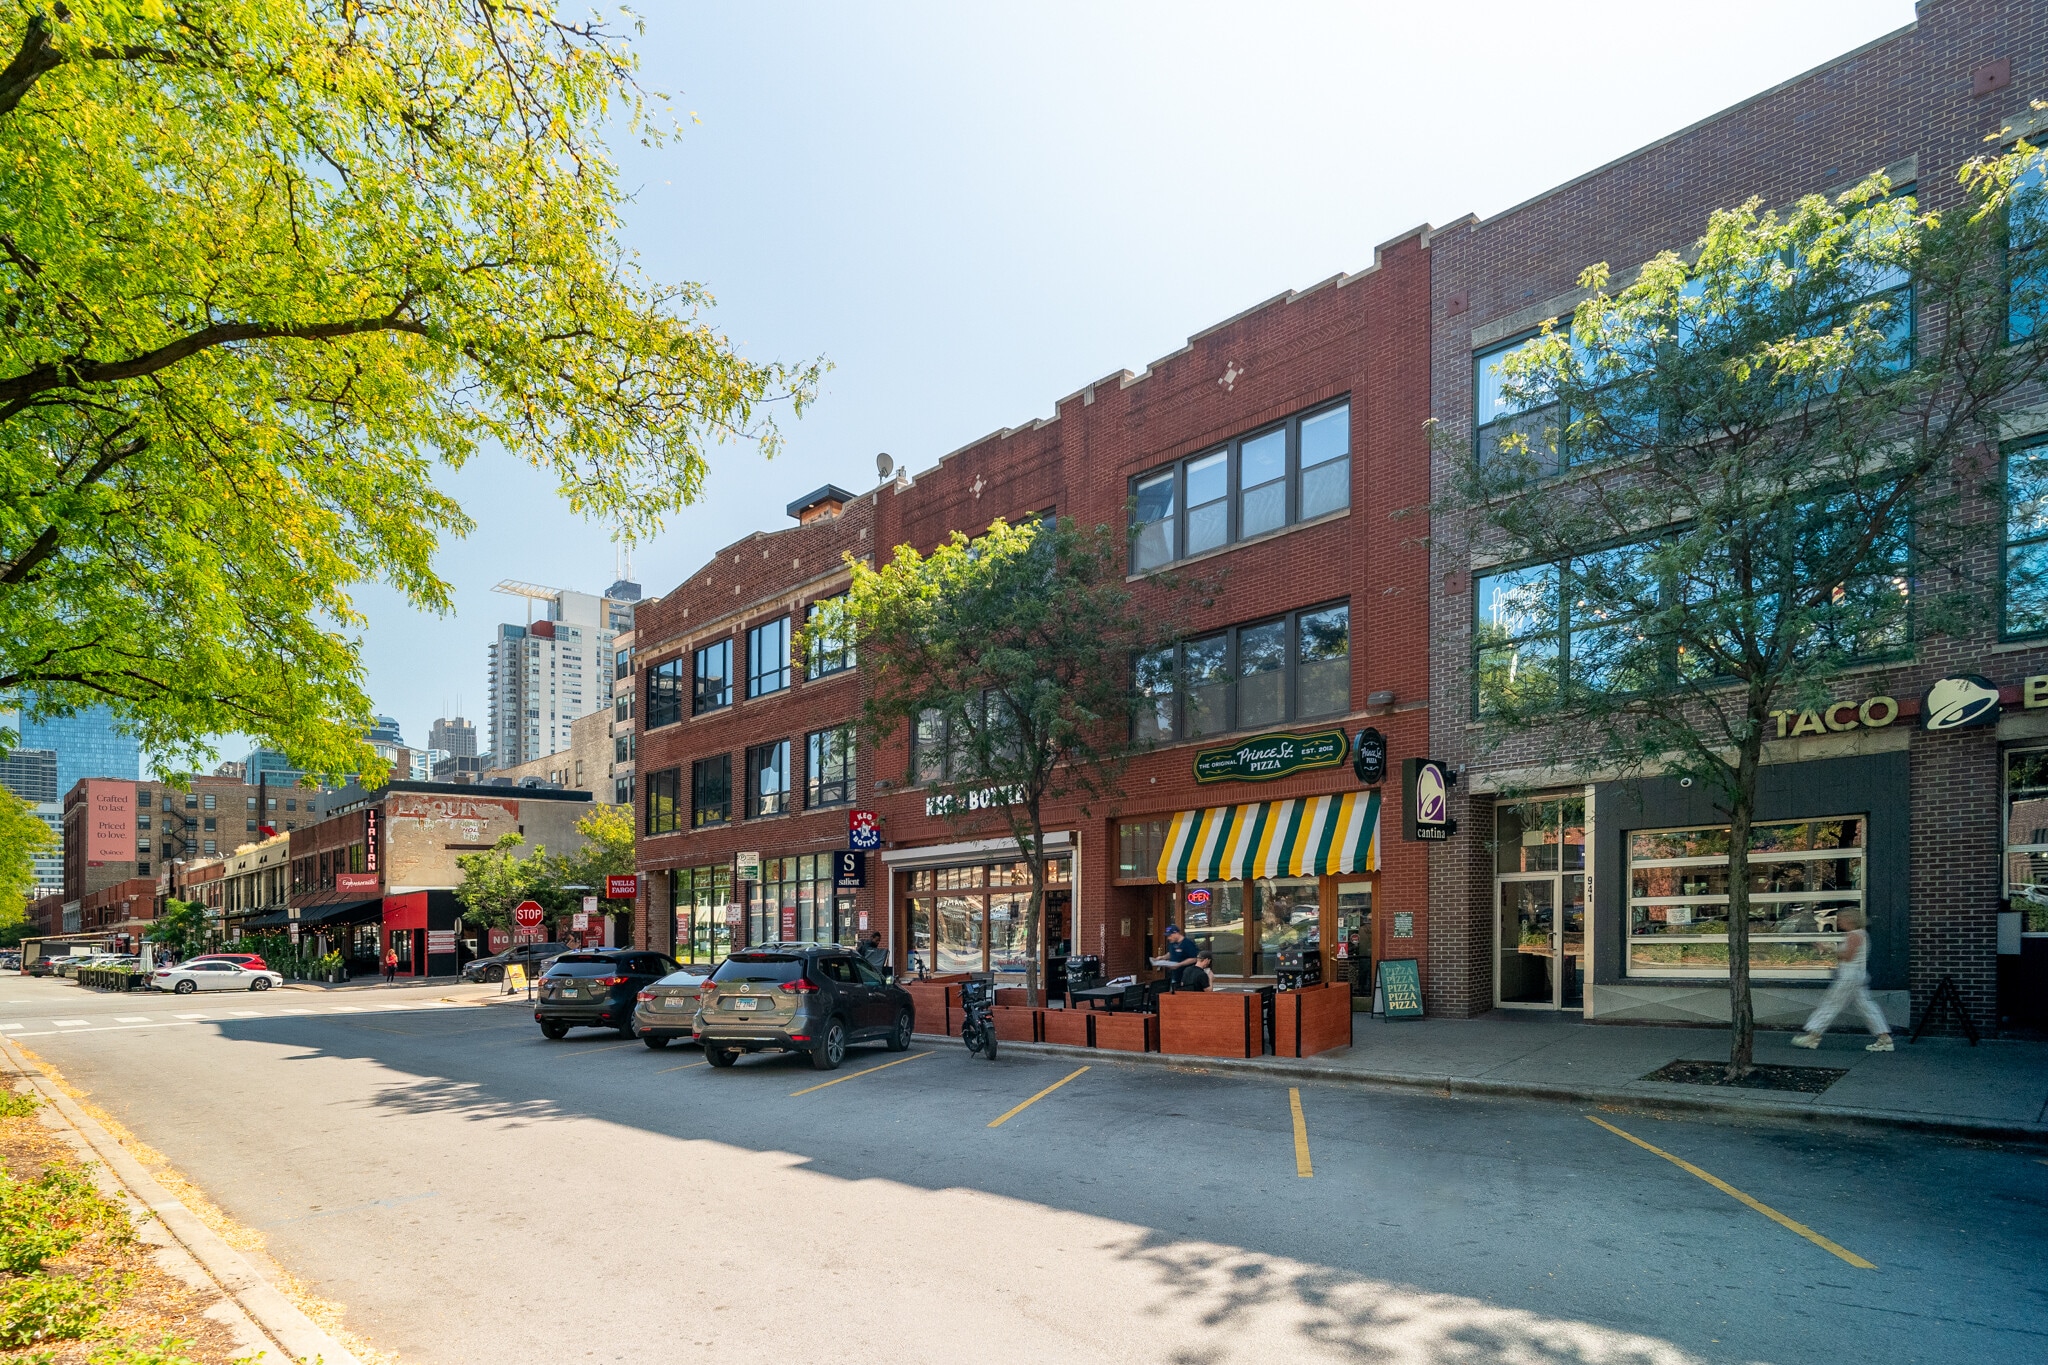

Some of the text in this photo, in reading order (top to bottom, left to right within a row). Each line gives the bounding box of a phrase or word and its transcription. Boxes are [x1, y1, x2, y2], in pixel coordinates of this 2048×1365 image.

[1769, 696, 1899, 738] TACO
[1212, 760, 1237, 768] ORIGINAL
[1237, 748, 1277, 765] Prince
[1250, 760, 1281, 771] PIZZA
[96, 794, 128, 803] Crafted
[109, 804, 126, 812] last.
[857, 812, 872, 820] KEG
[108, 831, 127, 839] love.
[1417, 827, 1446, 838] cantina
[367, 810, 376, 871] ITALIAN
[853, 835, 878, 847] BOTTLE
[843, 853, 855, 871] S
[838, 877, 860, 885] salient
[1187, 893, 1209, 902] OPEN
[517, 909, 541, 919] STOP
[1386, 975, 1414, 984] PIZZA
[1387, 984, 1416, 992] PIZZA
[1388, 992, 1417, 1001] PIZZA
[1389, 1001, 1418, 1010] PIZZA
